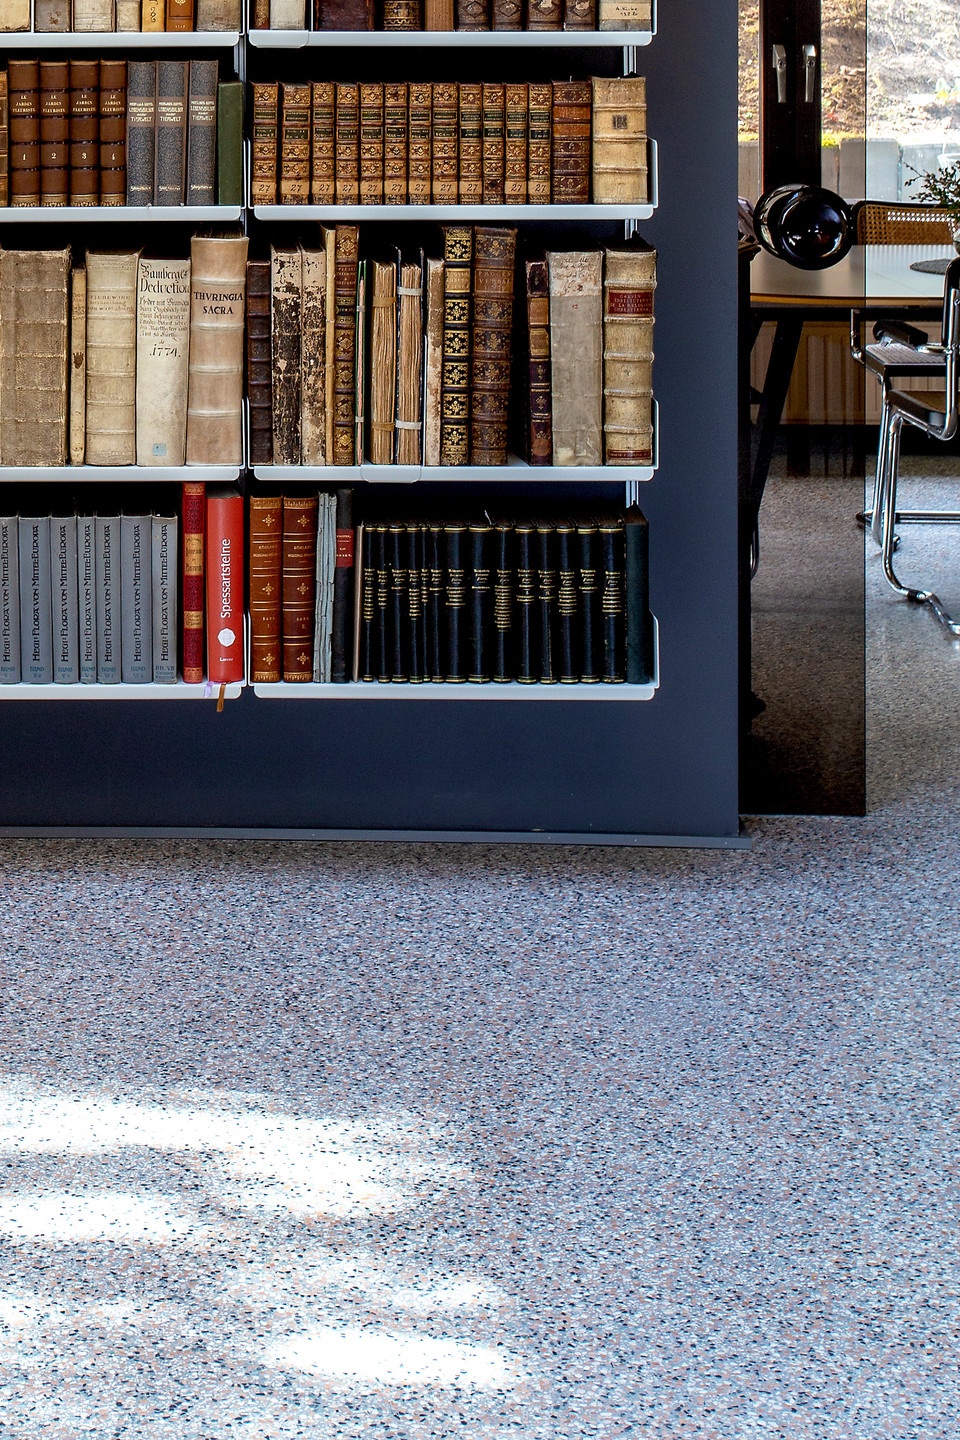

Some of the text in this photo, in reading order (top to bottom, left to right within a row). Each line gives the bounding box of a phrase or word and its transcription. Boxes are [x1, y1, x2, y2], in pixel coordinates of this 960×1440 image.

[194, 292, 243, 301] THVRINGIA
[203, 306, 233, 315] SACRA
[221, 538, 231, 618] Spessartsteine
